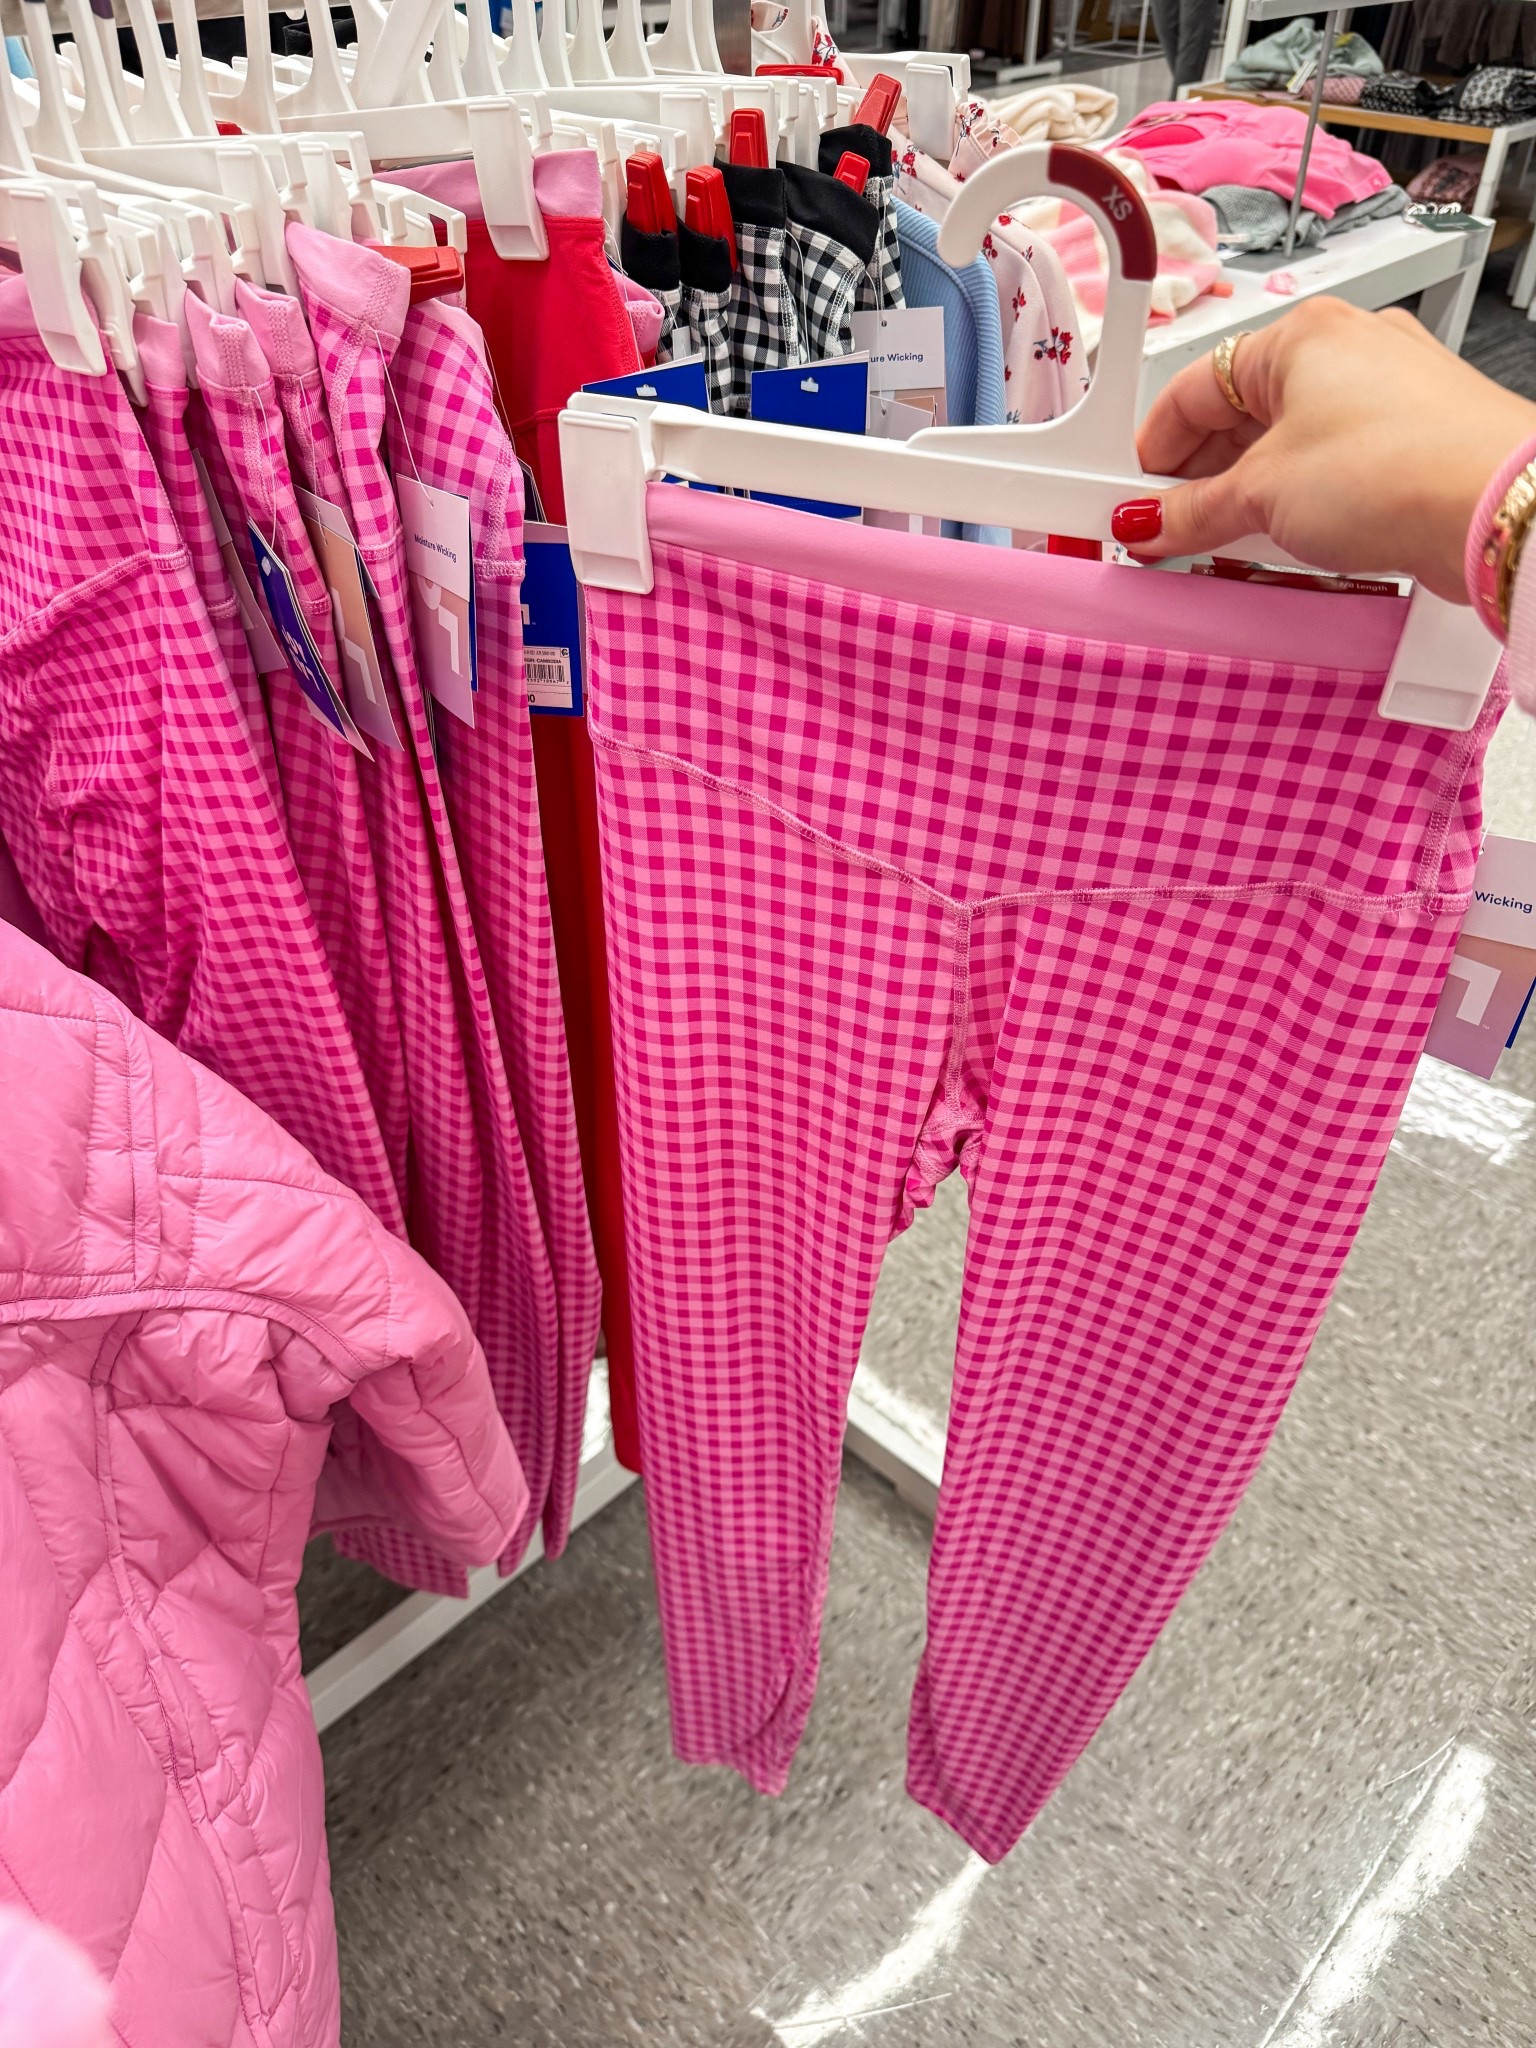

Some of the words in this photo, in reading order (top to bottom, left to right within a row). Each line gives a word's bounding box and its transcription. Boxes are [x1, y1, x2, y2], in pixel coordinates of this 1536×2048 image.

[1101, 185, 1133, 221] XS
[887, 352, 924, 362] Wicking
[414, 533, 436, 551] Moisture
[436, 542, 457, 563] Wicking
[1356, 582, 1388, 592] Length
[1474, 890, 1534, 914] Wicking
